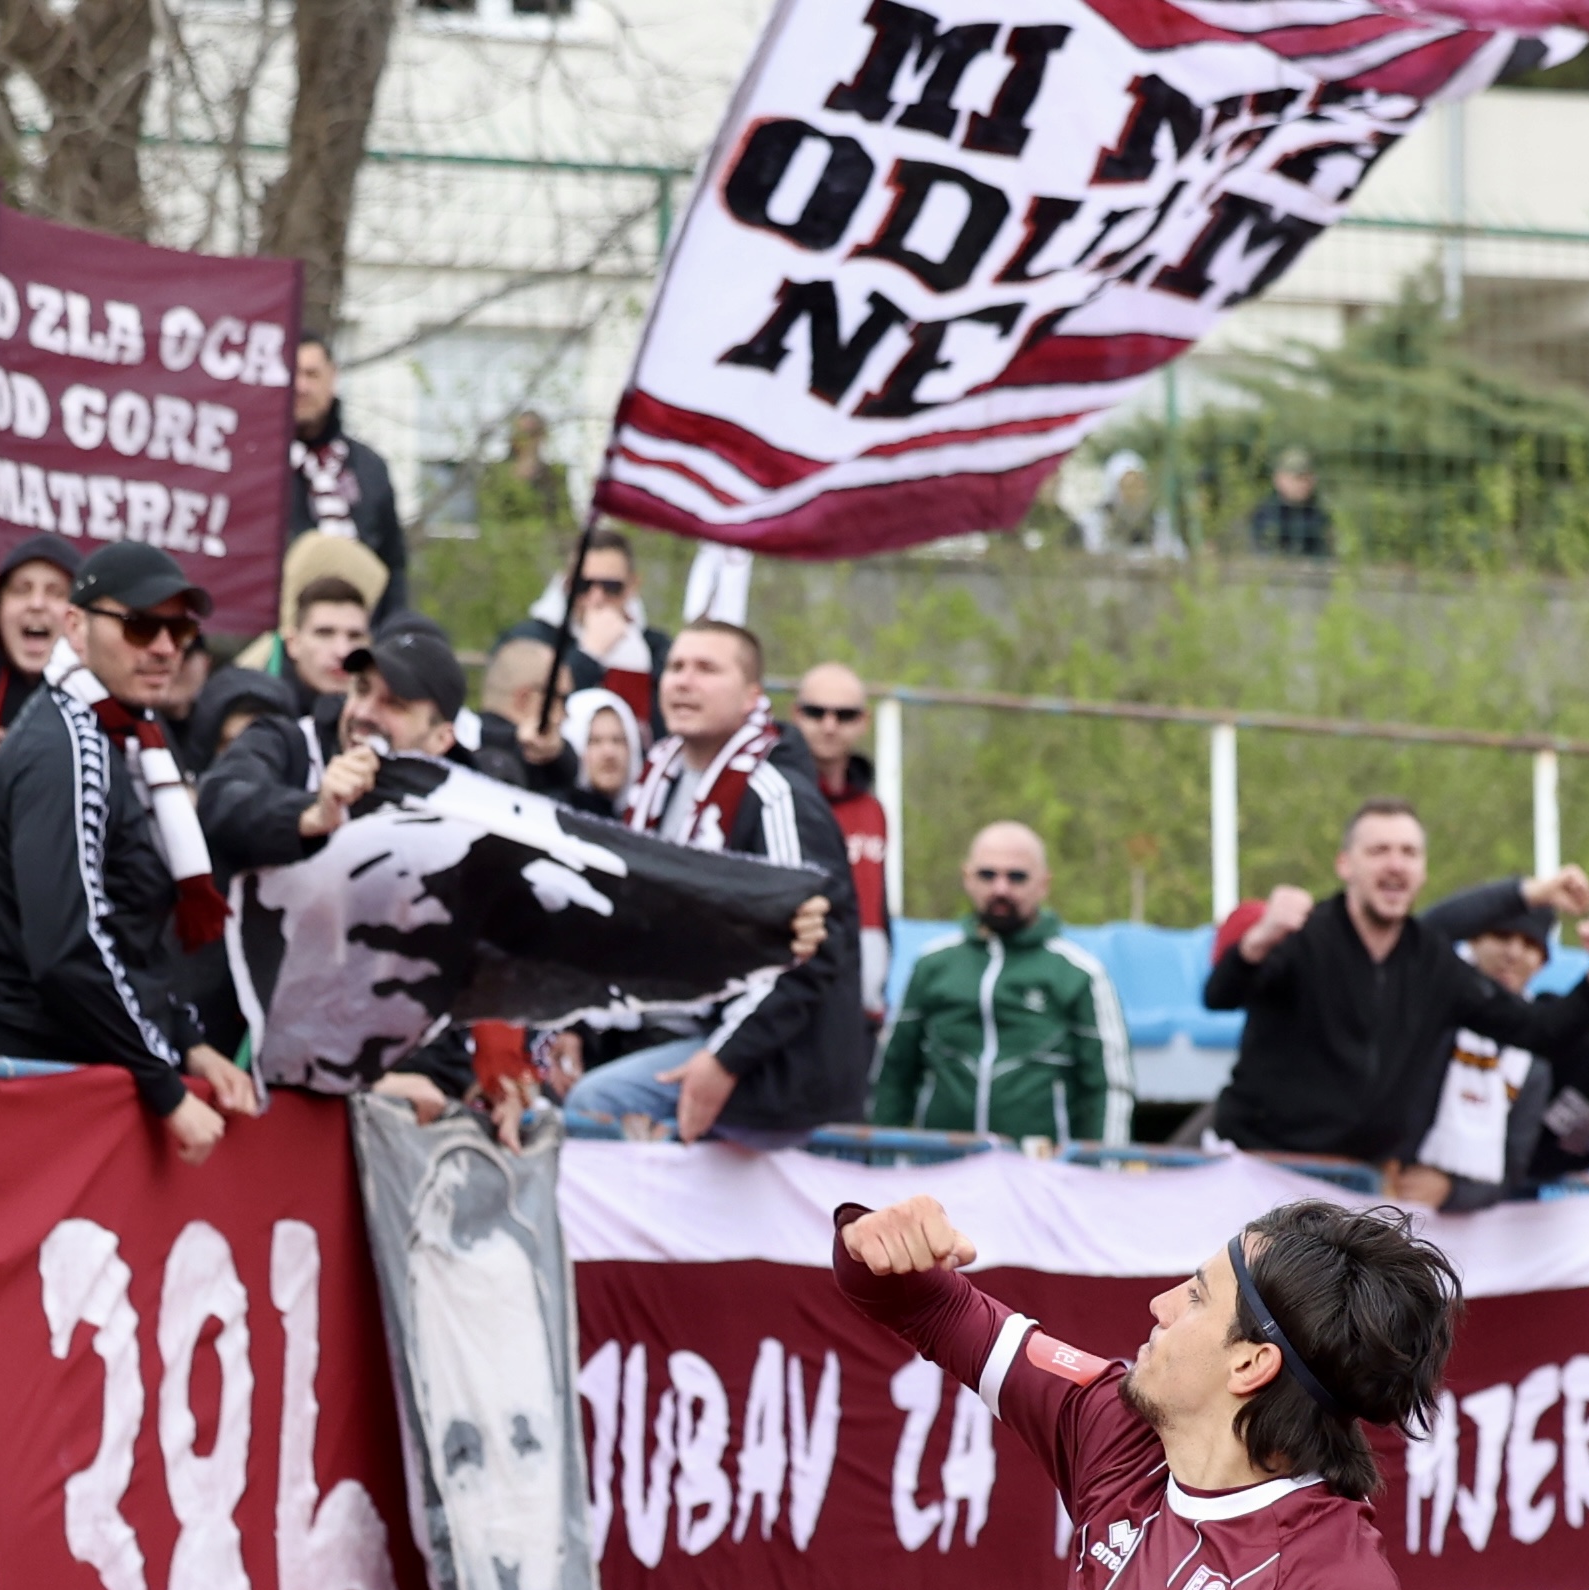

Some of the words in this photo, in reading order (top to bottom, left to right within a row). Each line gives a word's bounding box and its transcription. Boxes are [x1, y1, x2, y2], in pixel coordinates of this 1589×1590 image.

[823, 0, 1073, 157] MI
[25, 280, 146, 366] ZLA
[158, 304, 291, 388] OCA
[60, 382, 239, 473] GORE
[1090, 1541, 1123, 1572] erre
